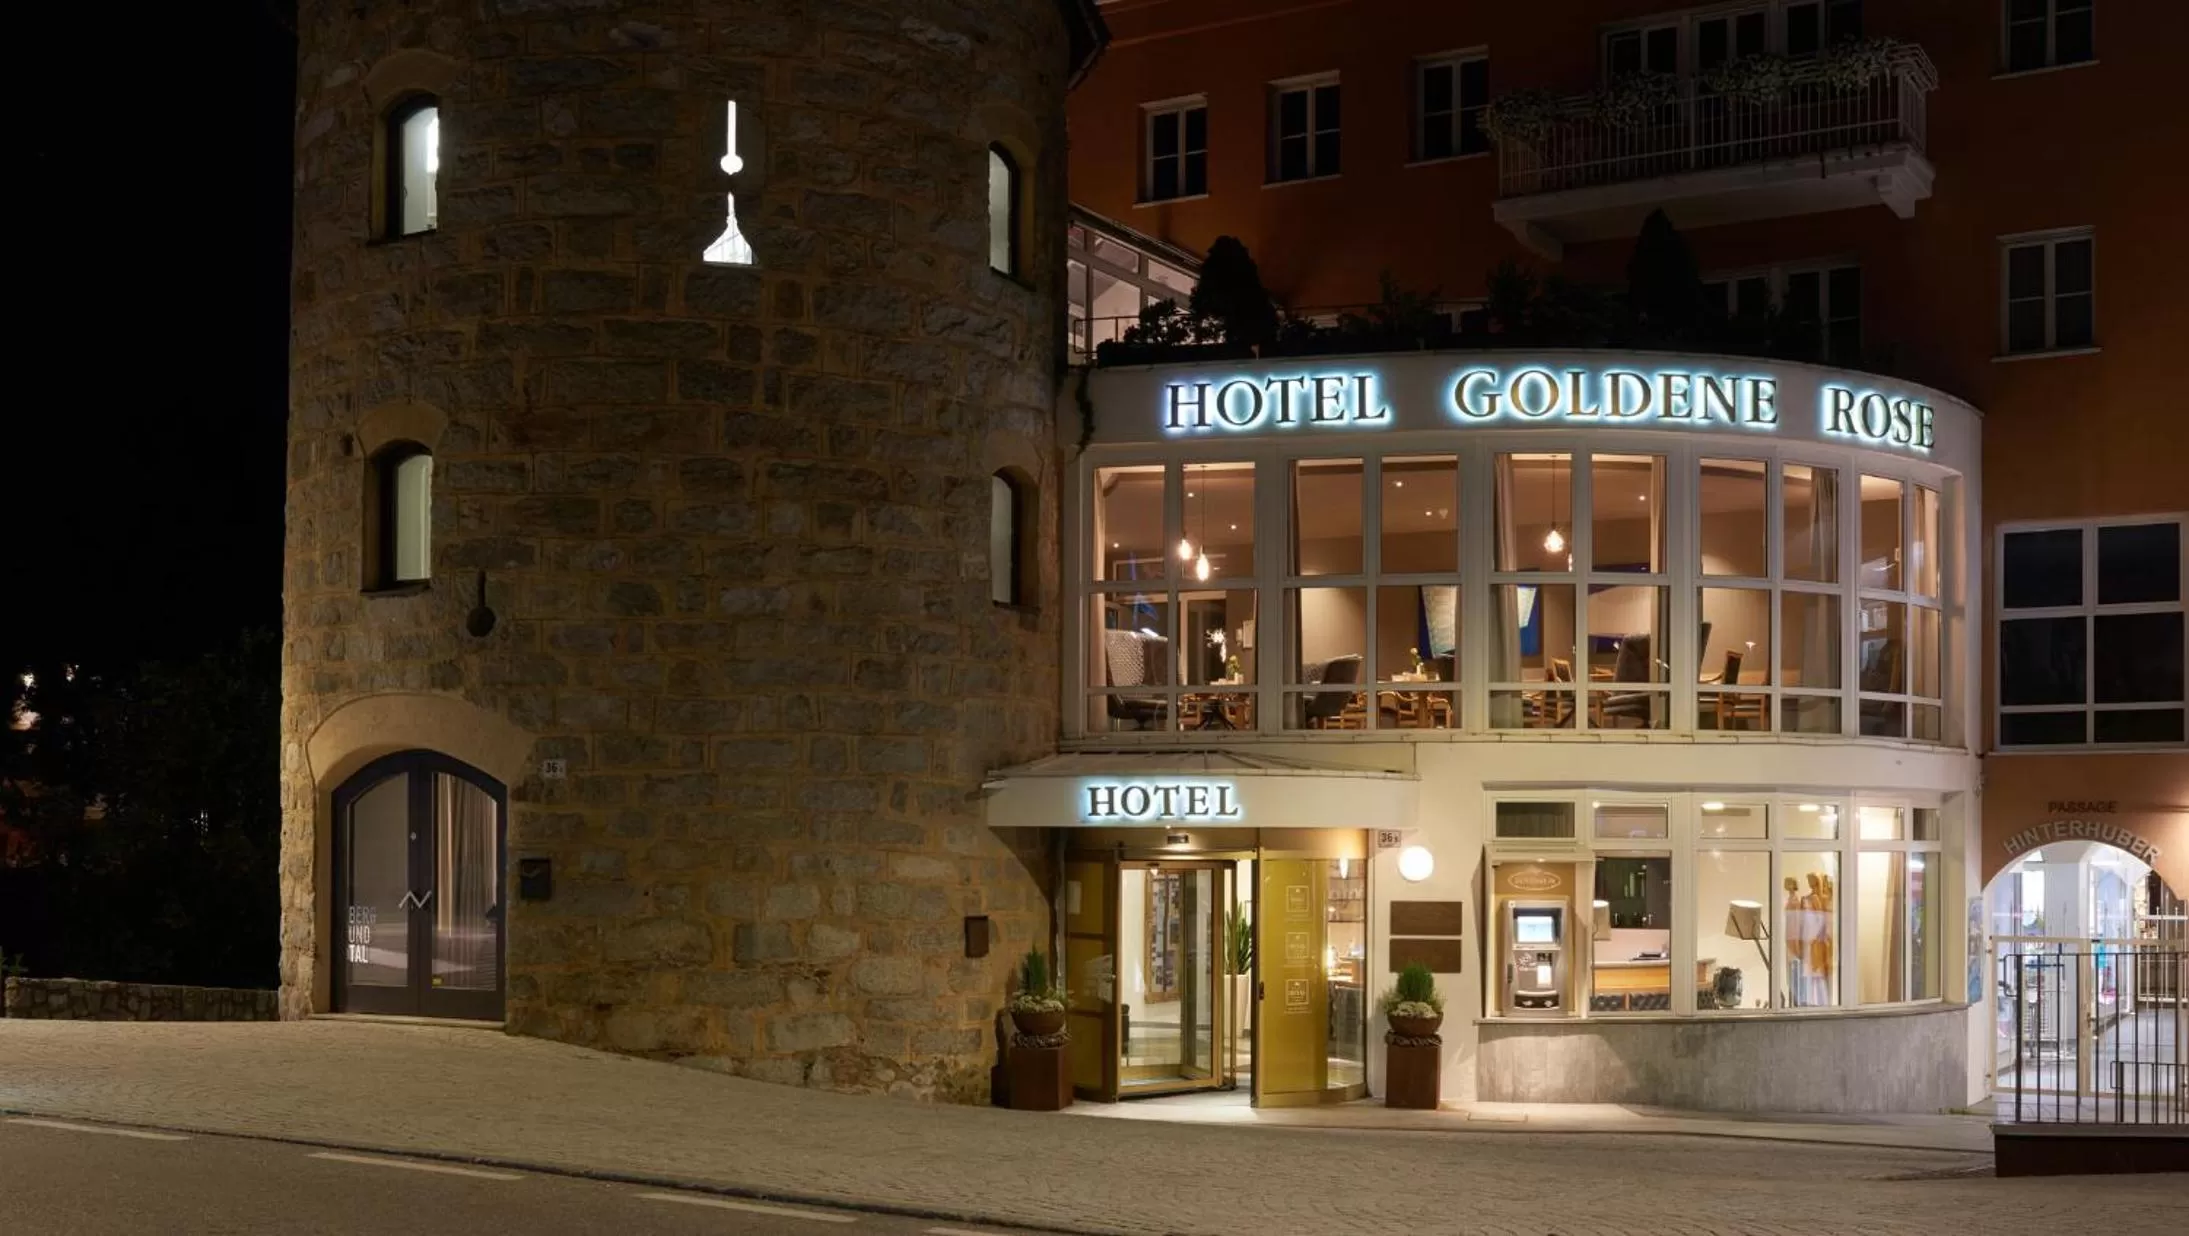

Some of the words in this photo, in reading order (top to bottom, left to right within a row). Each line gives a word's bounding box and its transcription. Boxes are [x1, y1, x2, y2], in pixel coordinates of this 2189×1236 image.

[1164, 373, 1389, 429] HOTEL
[1453, 368, 1779, 424] GOLDENE
[1824, 386, 1936, 449] ROSE
[1086, 784, 1240, 817] HOTEL
[2047, 800, 2119, 814] PASSAGE
[2002, 819, 2161, 863] HINTERHUBER
[348, 905, 377, 924] BERG
[347, 924, 371, 945] UND
[348, 944, 369, 963] TAL
